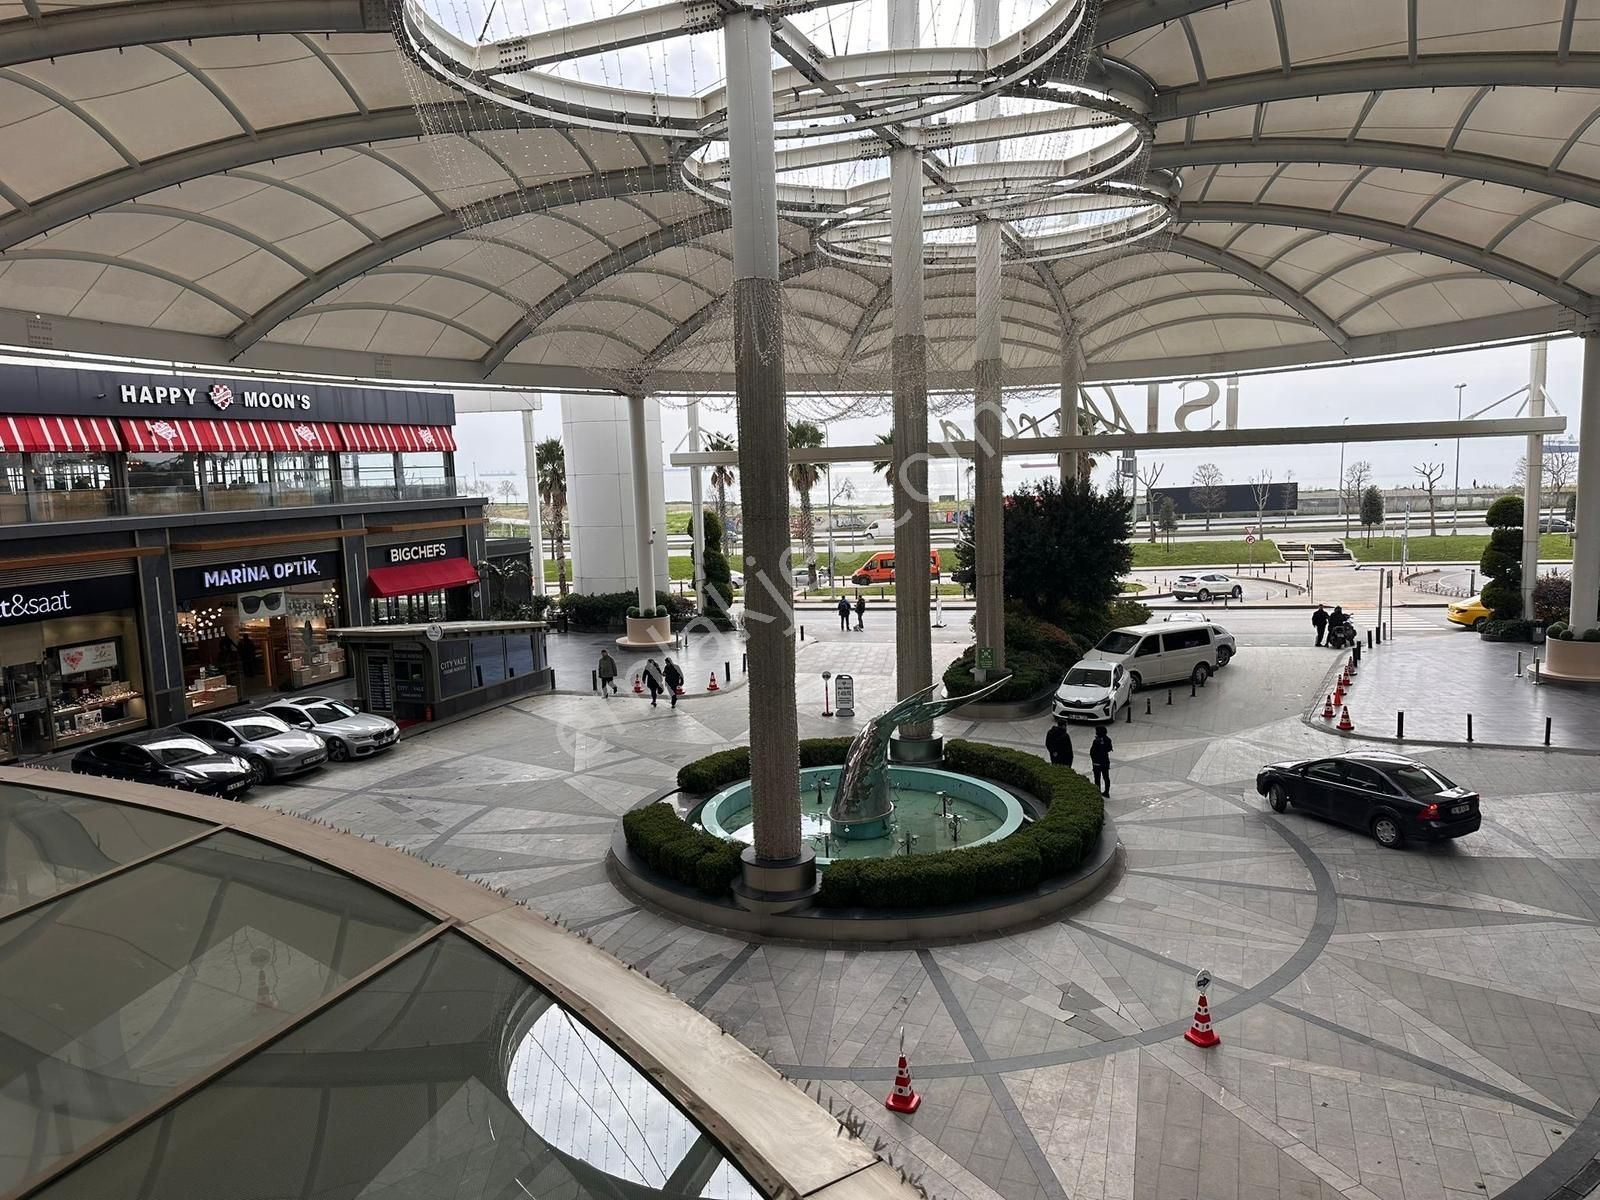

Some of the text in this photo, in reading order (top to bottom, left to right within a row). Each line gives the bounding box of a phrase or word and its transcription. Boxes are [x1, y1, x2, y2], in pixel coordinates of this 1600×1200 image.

[120, 384, 197, 405] HAPPY
[243, 391, 311, 410] MOON'S
[389, 543, 447, 563] BIGCHEFS
[0, 590, 72, 618] t&saat
